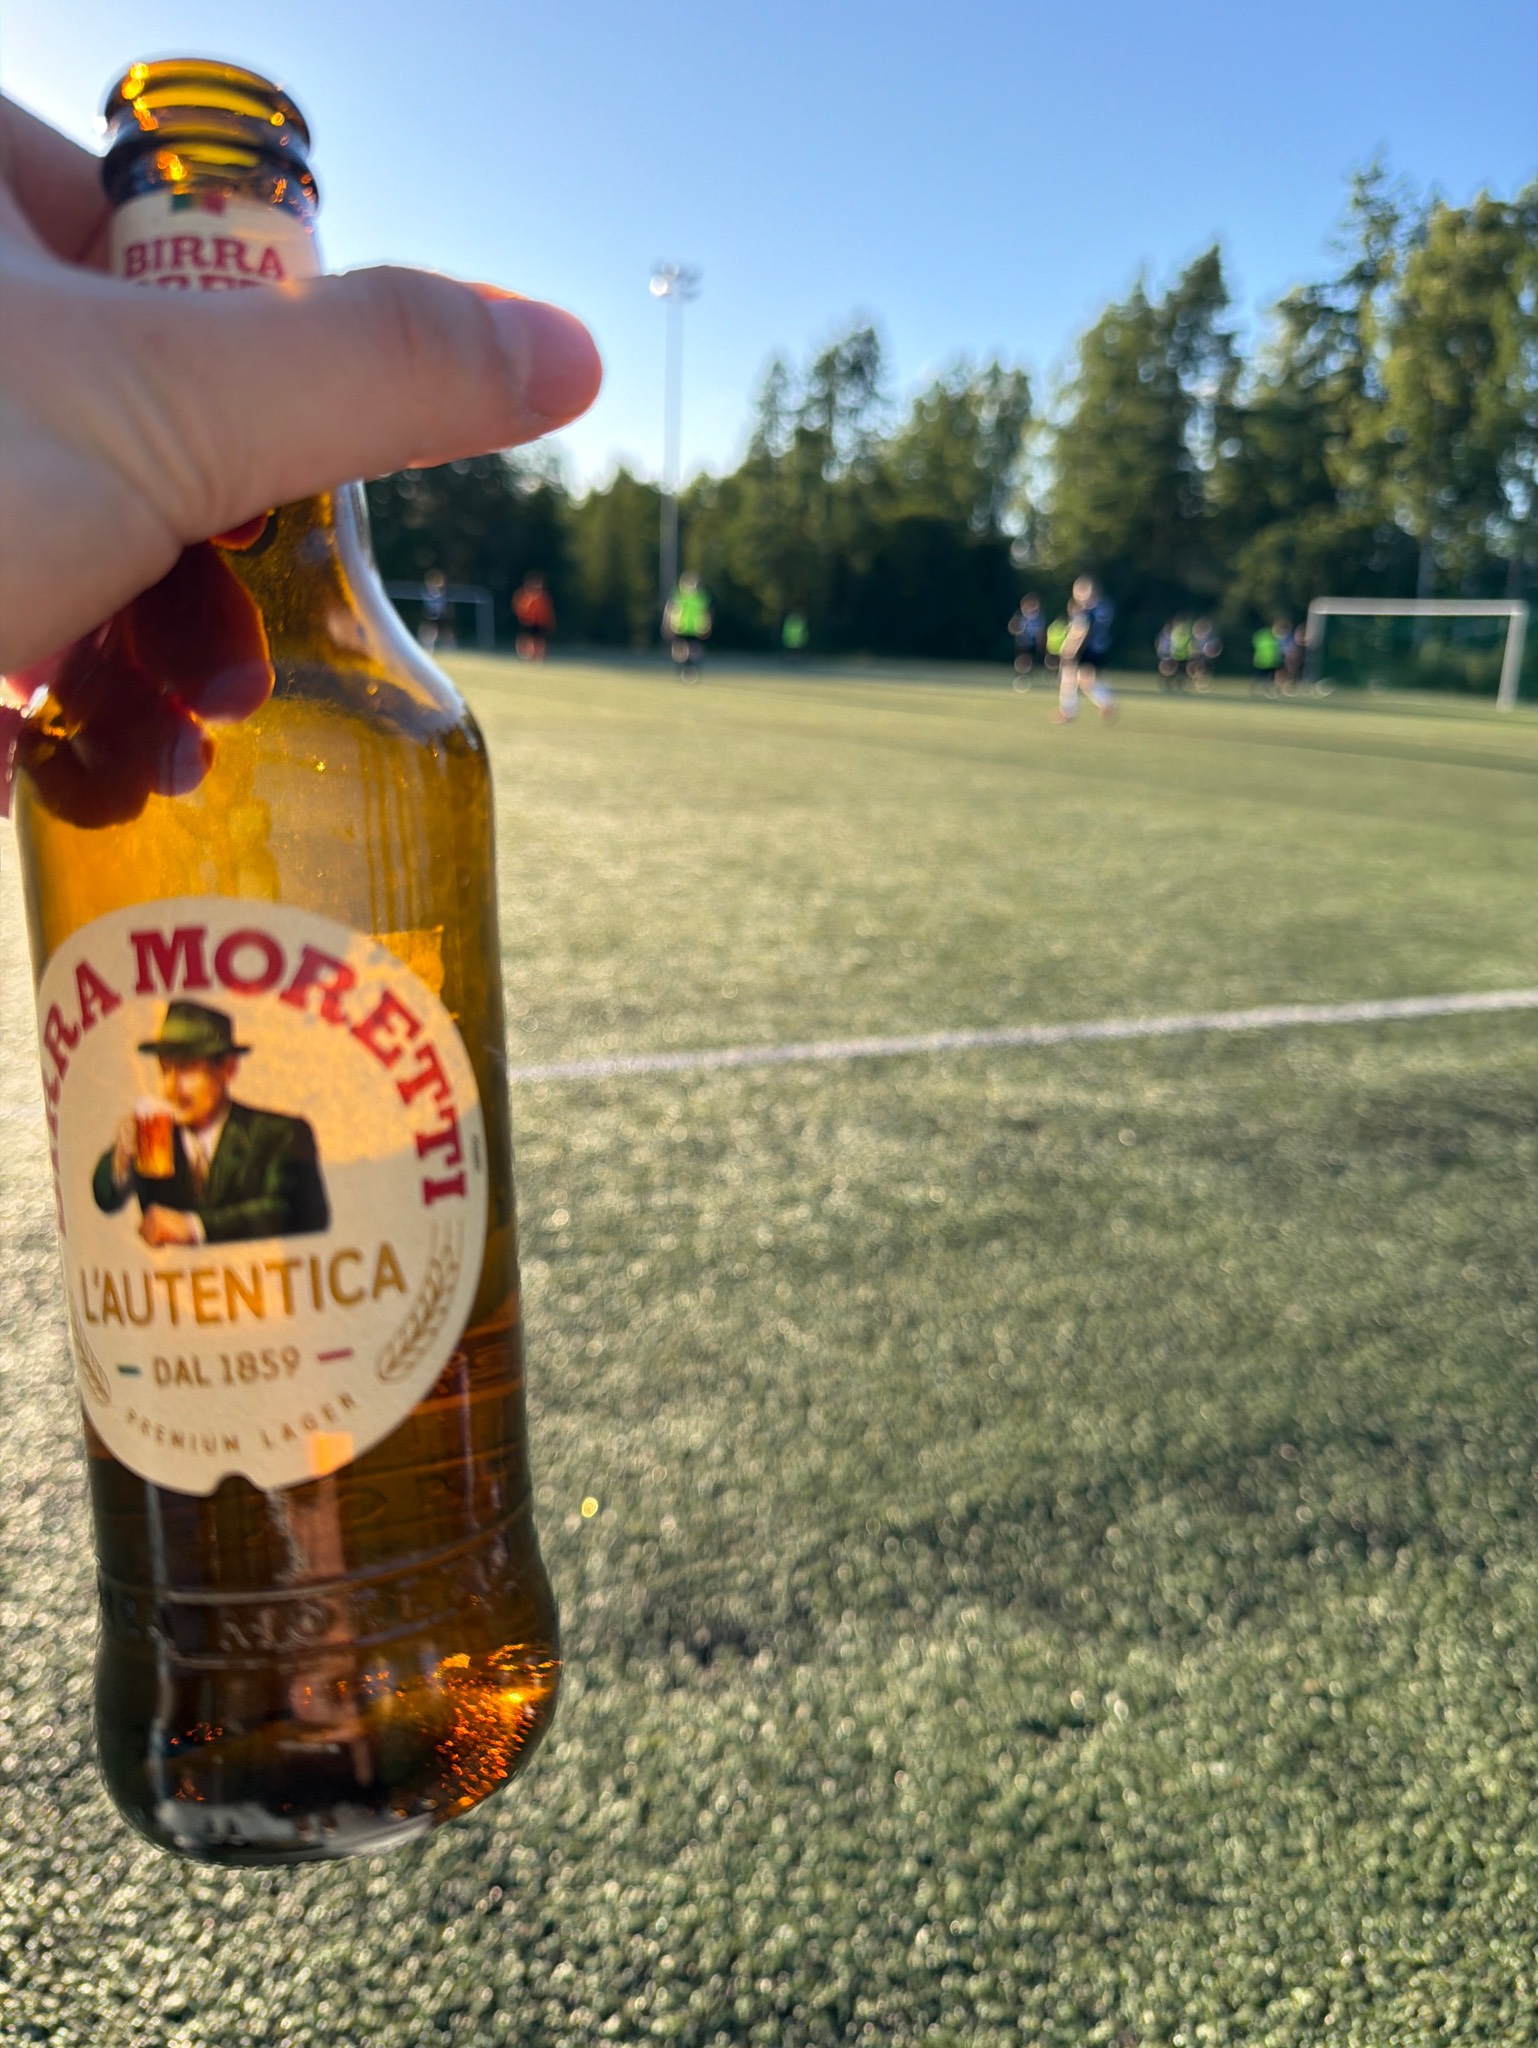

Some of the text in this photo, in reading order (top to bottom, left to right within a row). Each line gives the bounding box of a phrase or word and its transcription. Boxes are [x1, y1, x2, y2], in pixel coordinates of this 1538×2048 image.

[124, 235, 285, 281] BIRRA
[130, 925, 467, 1206] MORETTI
[79, 1240, 408, 1327] L'AUTENTICA
[152, 1345, 300, 1387] DAL 1859
[126, 1391, 356, 1455] PREMIUM LAGER
